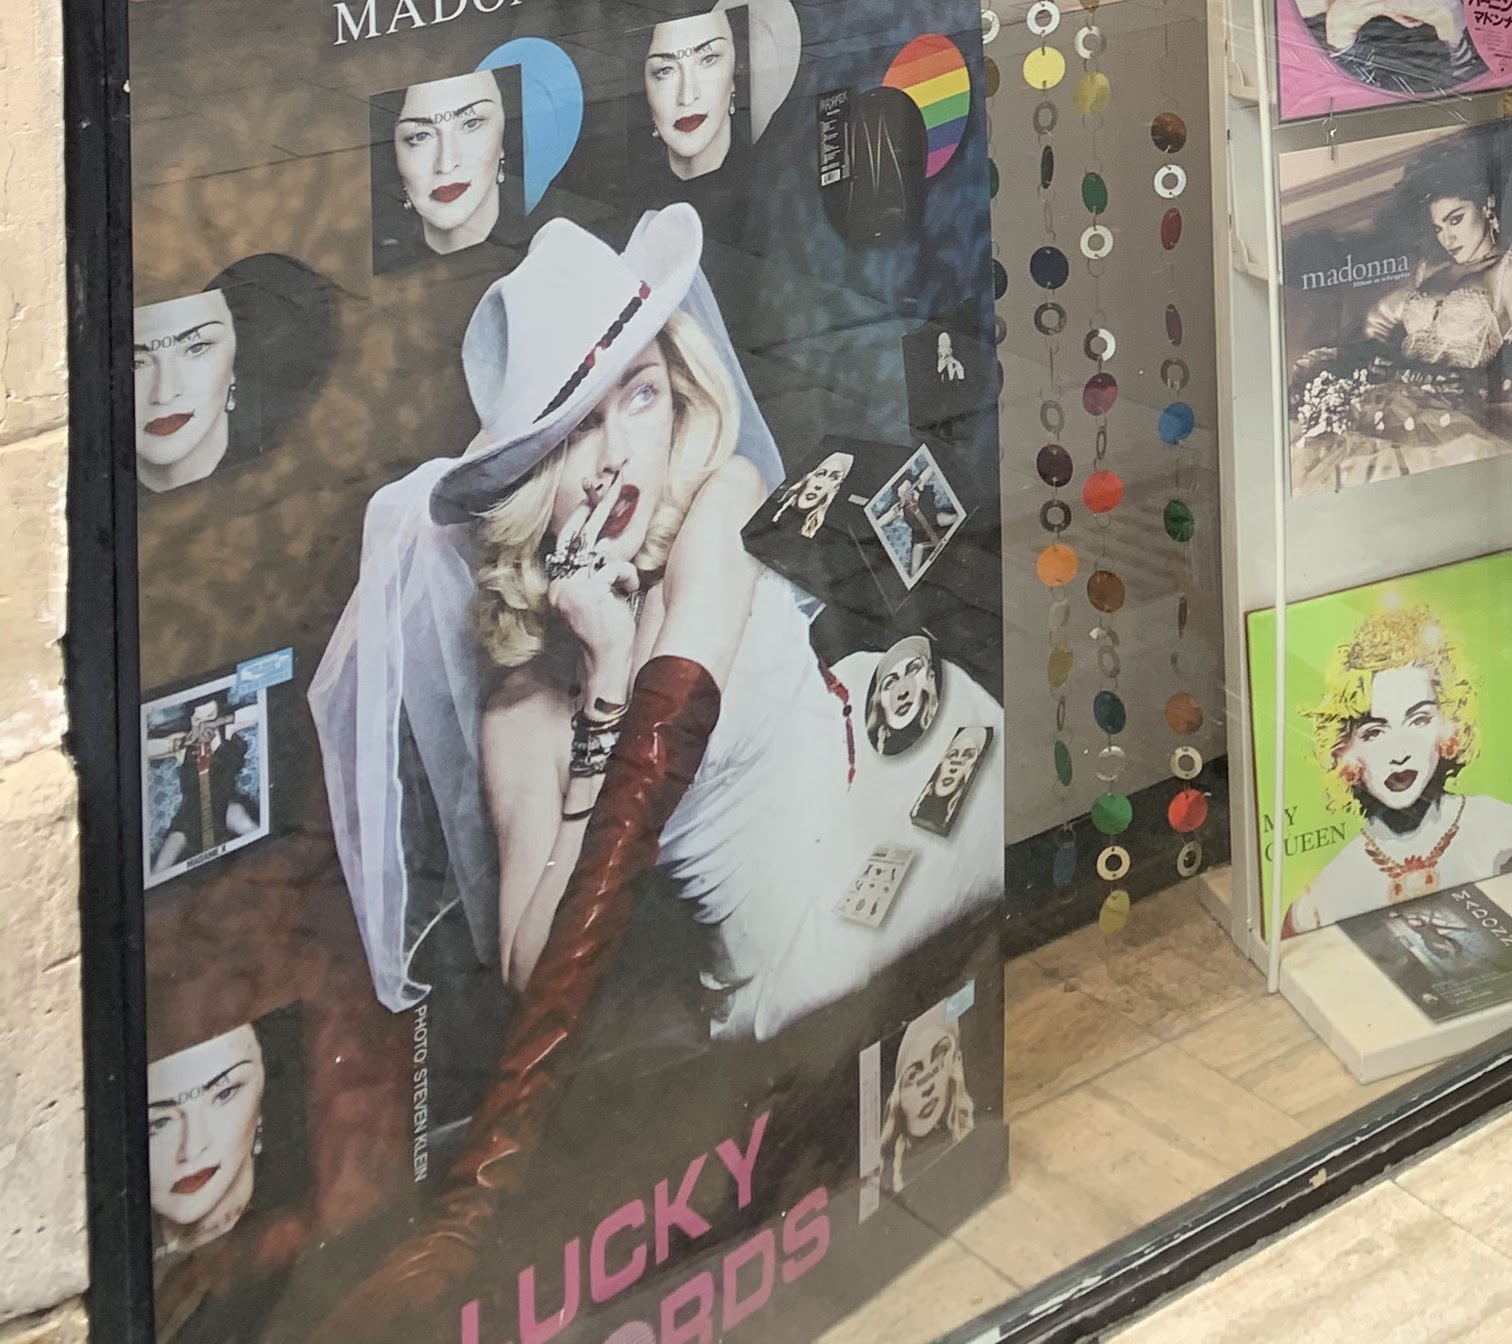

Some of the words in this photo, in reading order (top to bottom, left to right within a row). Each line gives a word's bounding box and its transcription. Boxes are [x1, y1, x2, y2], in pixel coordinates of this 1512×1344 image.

[1302, 254, 1409, 290] madonna
[413, 1068, 428, 1134] STEVEN
[413, 1133, 428, 1183] KLEIN
[462, 1112, 770, 1344] LUCKY
